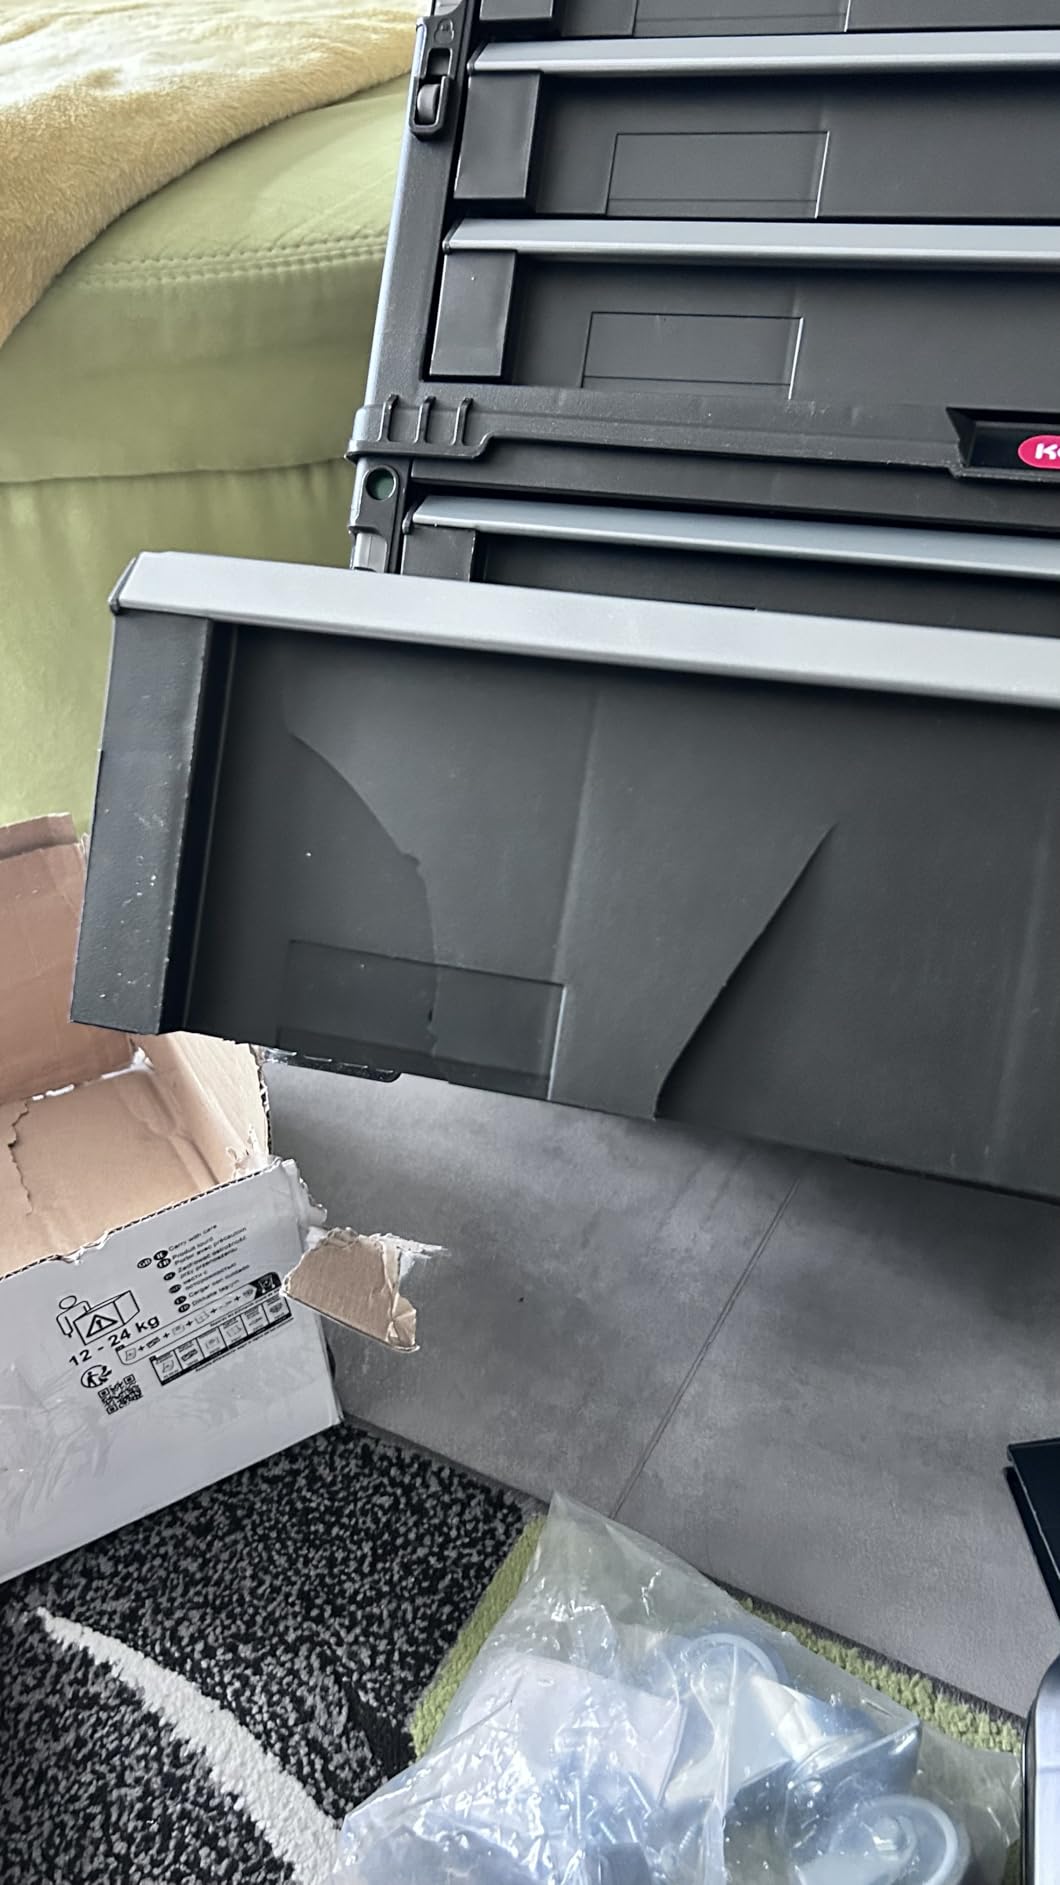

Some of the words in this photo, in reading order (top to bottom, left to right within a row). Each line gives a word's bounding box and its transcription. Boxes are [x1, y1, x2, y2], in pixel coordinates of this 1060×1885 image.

[168, 1241, 186, 1251] Carry
[188, 1233, 201, 1241] with
[203, 1225, 217, 1234] care
[172, 1246, 196, 1260] Produit
[196, 1245, 212, 1255] avec
[69, 1350, 92, 1366] 12
[108, 1328, 131, 1347] 24
[135, 1316, 160, 1333] kg
